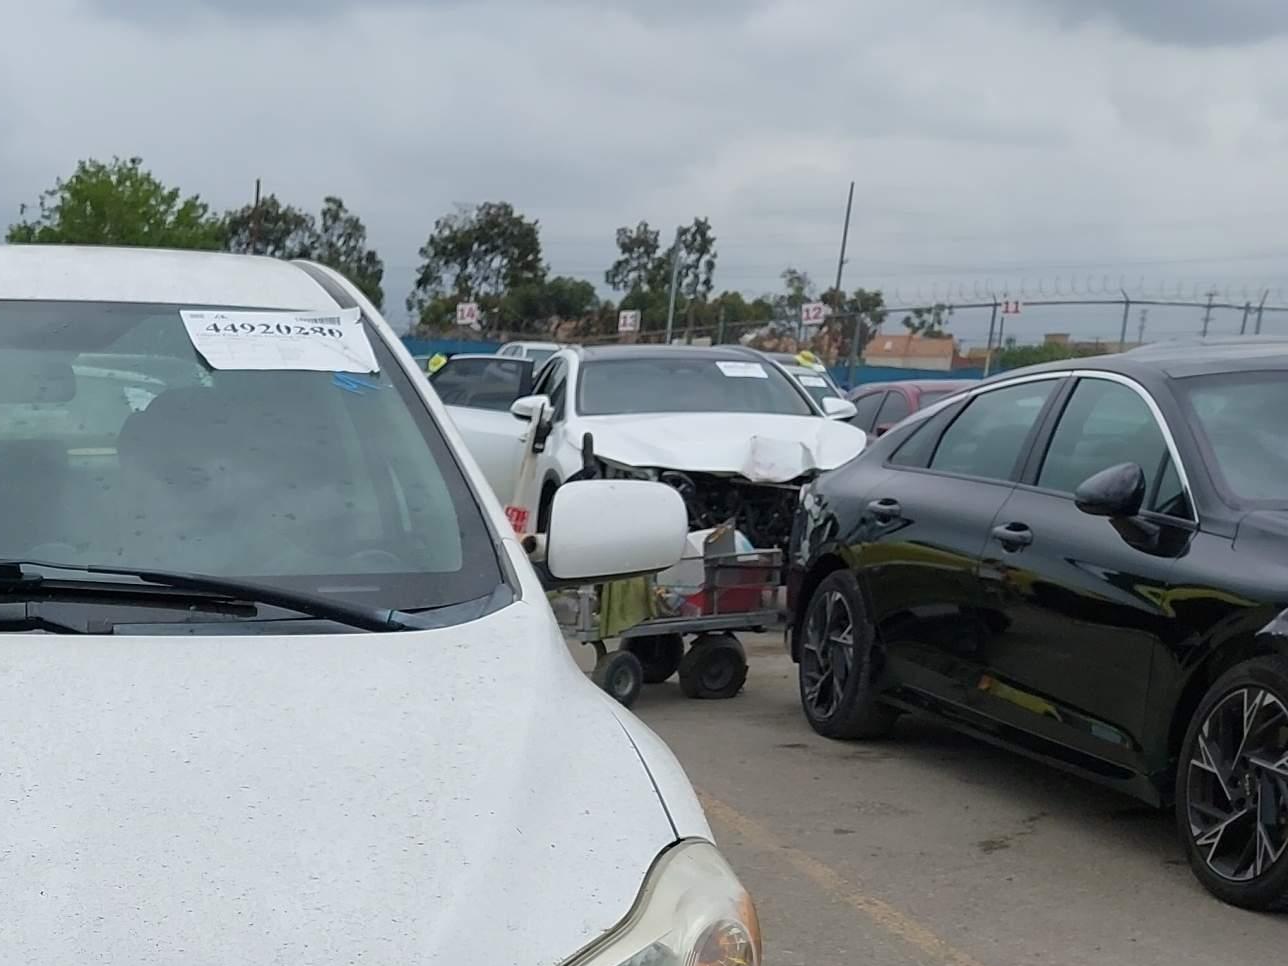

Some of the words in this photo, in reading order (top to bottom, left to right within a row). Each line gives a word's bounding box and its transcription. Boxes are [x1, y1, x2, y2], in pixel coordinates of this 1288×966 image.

[802, 307, 822, 321] 12
[1001, 300, 1020, 314] 11
[205, 322, 343, 339] 44920280
